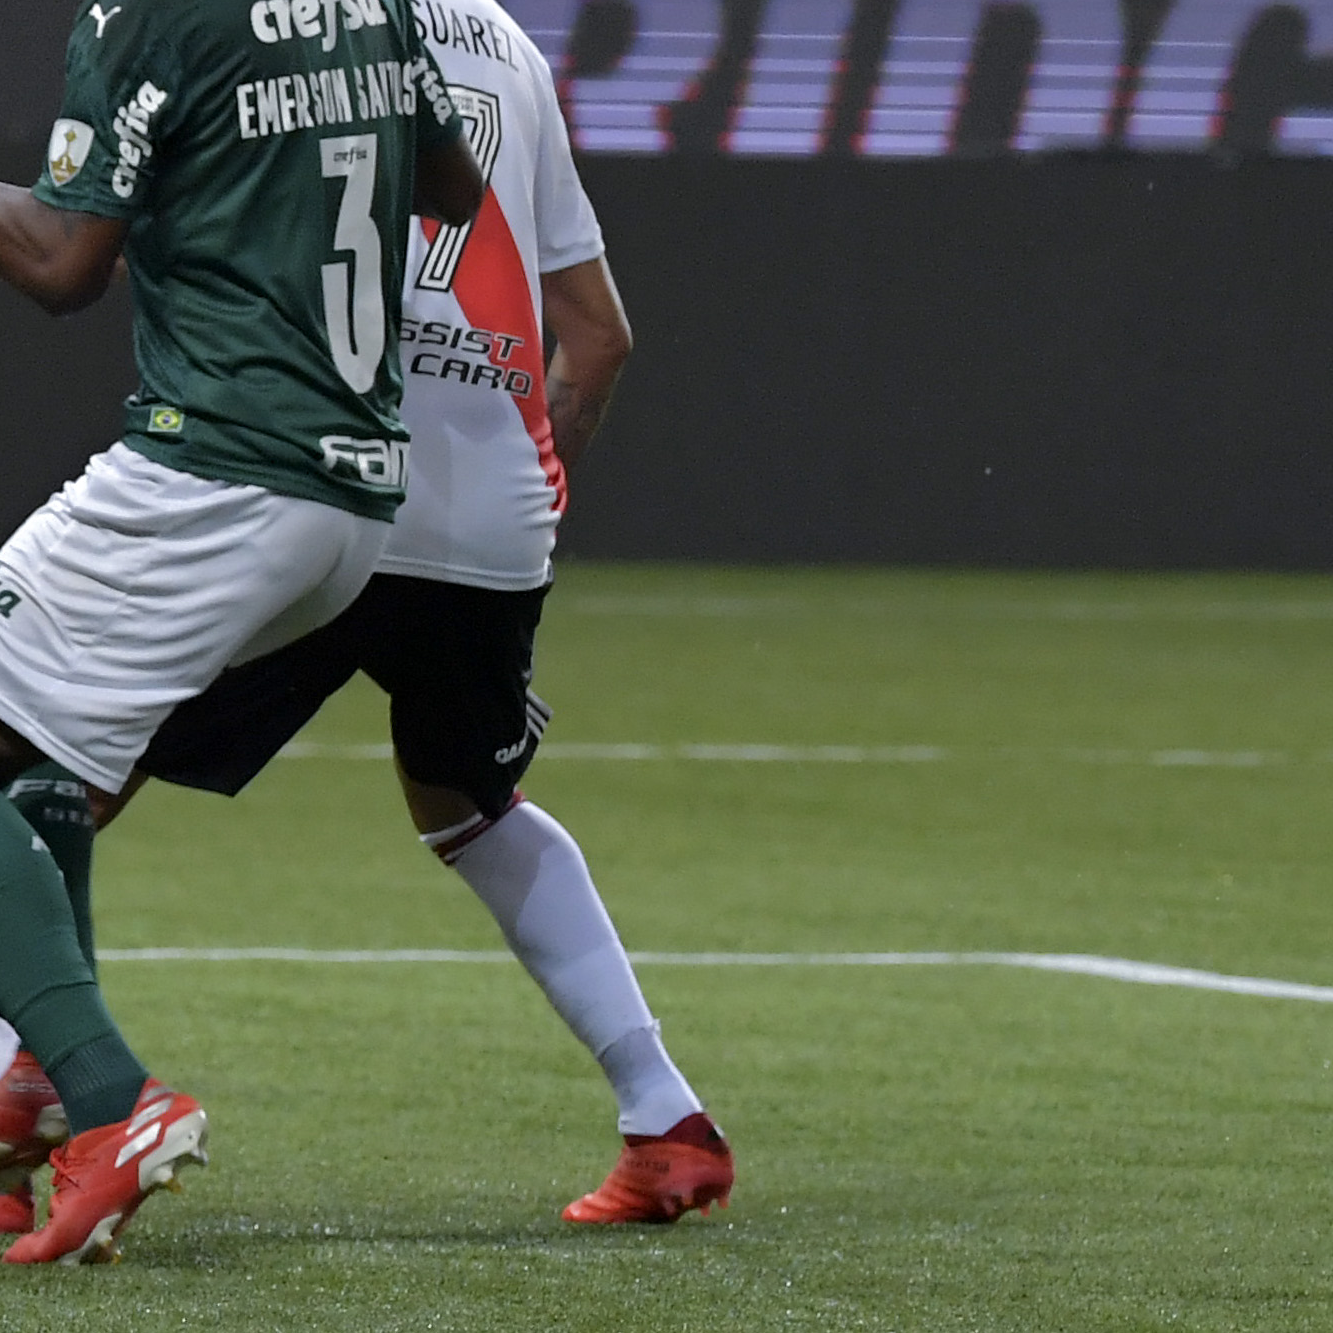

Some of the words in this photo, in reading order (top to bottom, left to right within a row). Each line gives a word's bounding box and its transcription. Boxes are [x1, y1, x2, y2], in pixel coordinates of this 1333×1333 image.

[112, 80, 168, 198] crefisa
[236, 68, 353, 139] EMERSON
[320, 133, 387, 395] 3
[399, 319, 525, 362] SSIST
[410, 353, 532, 398] CARD
